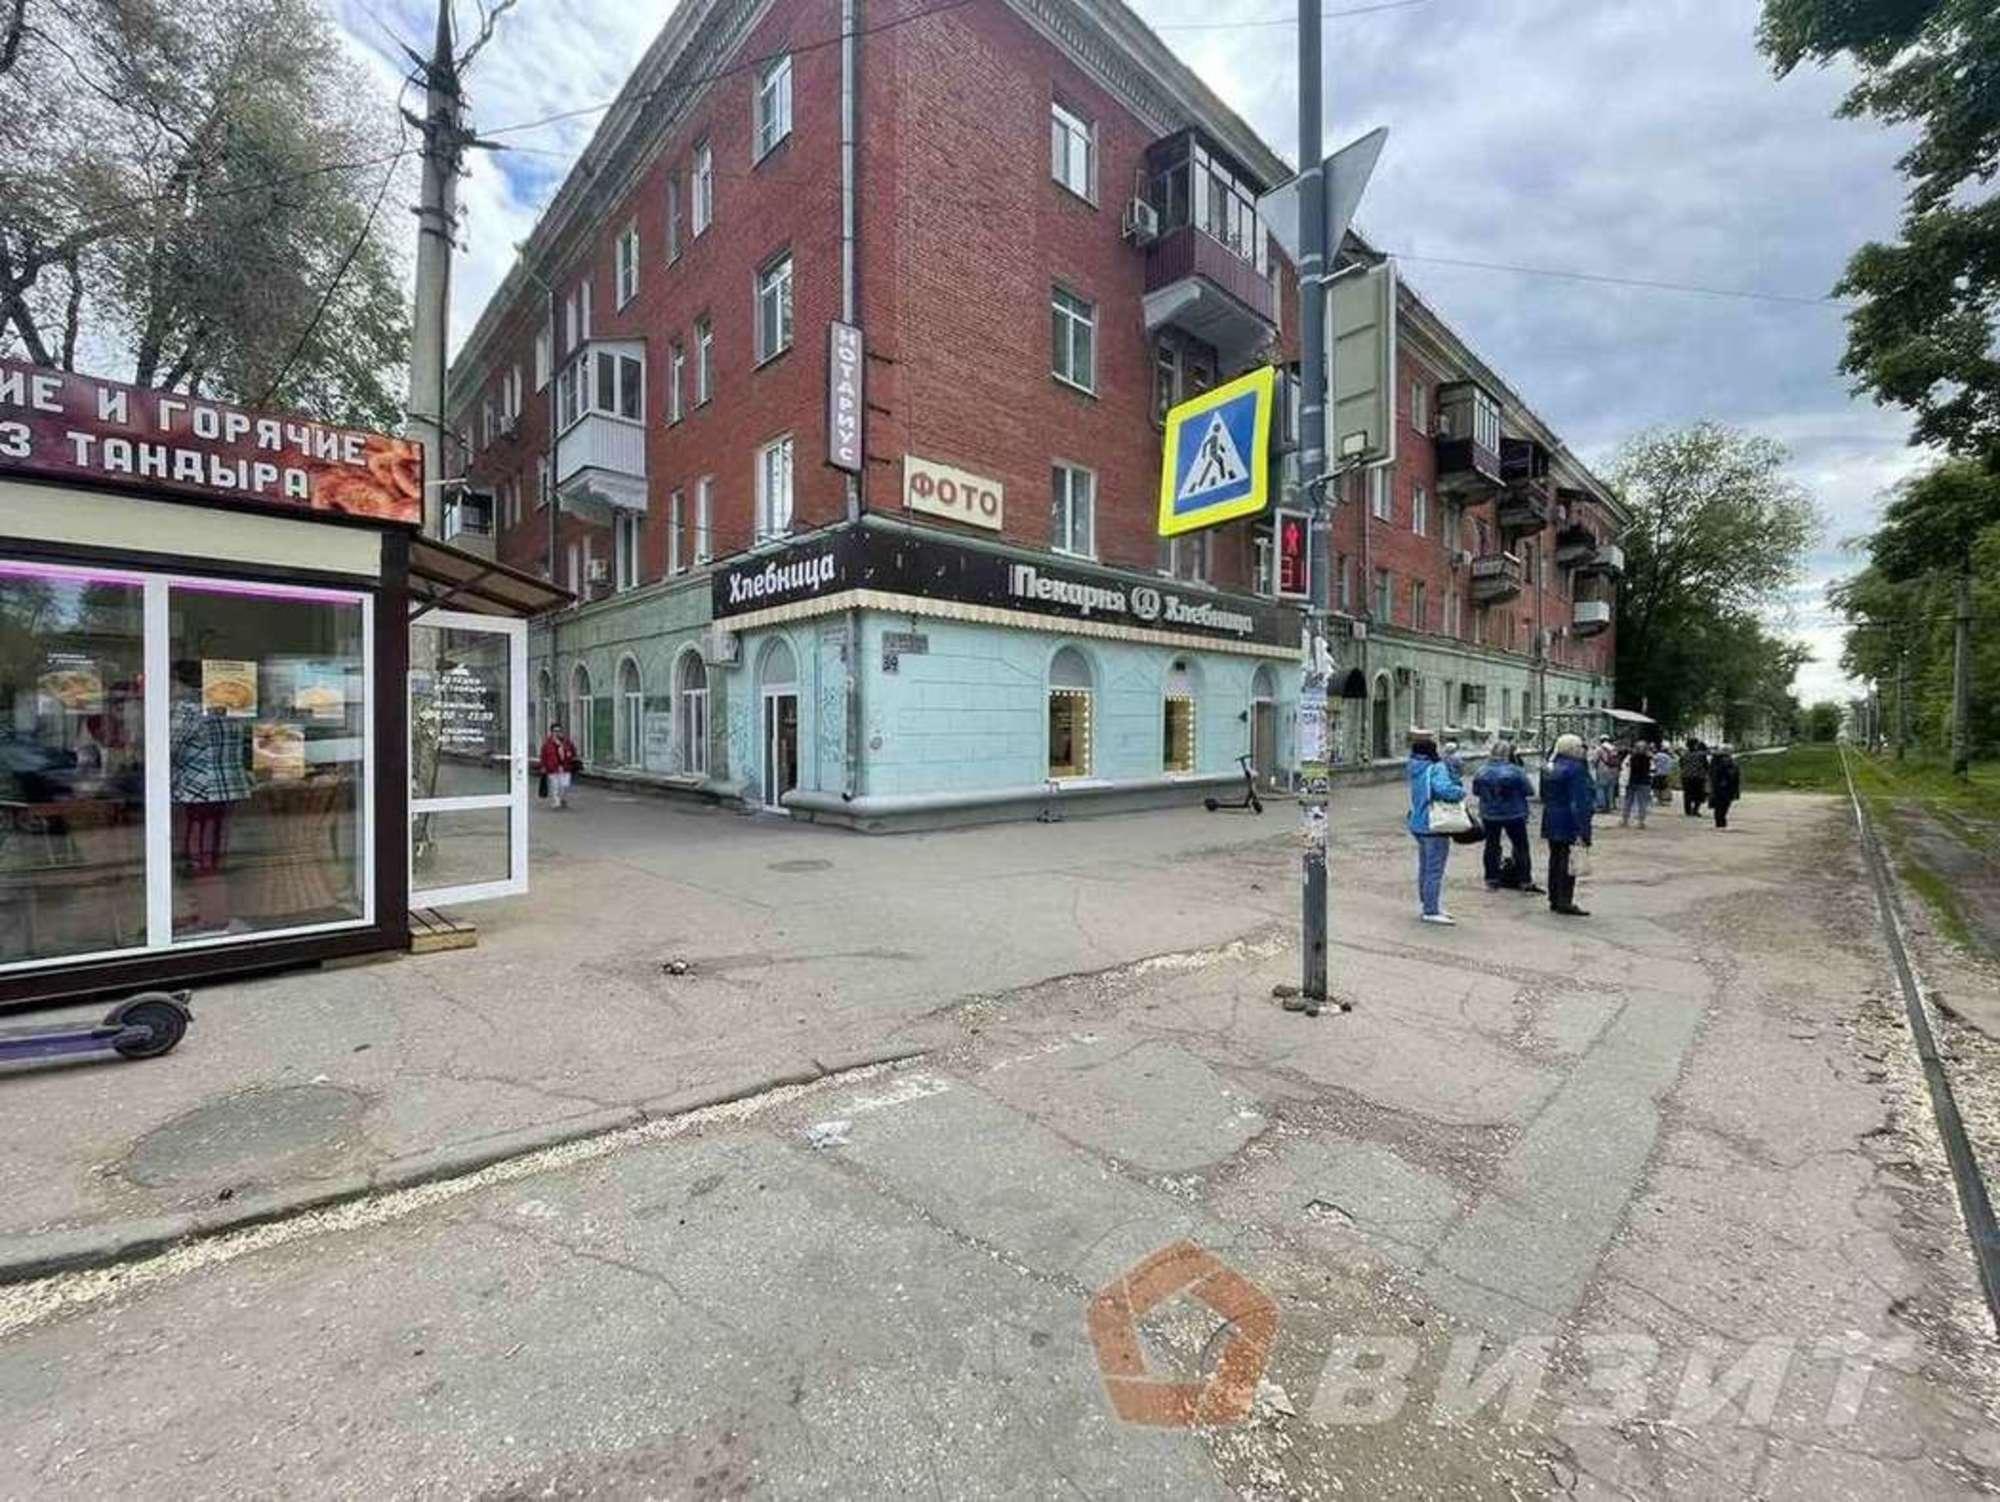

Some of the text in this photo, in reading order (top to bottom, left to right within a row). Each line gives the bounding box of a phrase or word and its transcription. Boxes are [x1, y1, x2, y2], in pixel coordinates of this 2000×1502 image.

[98, 387, 128, 424] И
[159, 399, 367, 467] ГОРЯЧИЕ
[837, 328, 857, 462] НОТАРИУС
[66, 431, 309, 499] ТАНДЫРА
[911, 471, 997, 526] ФОТО
[729, 553, 835, 604] Хлебница
[1008, 563, 1254, 637] Пекарня Хлебница
